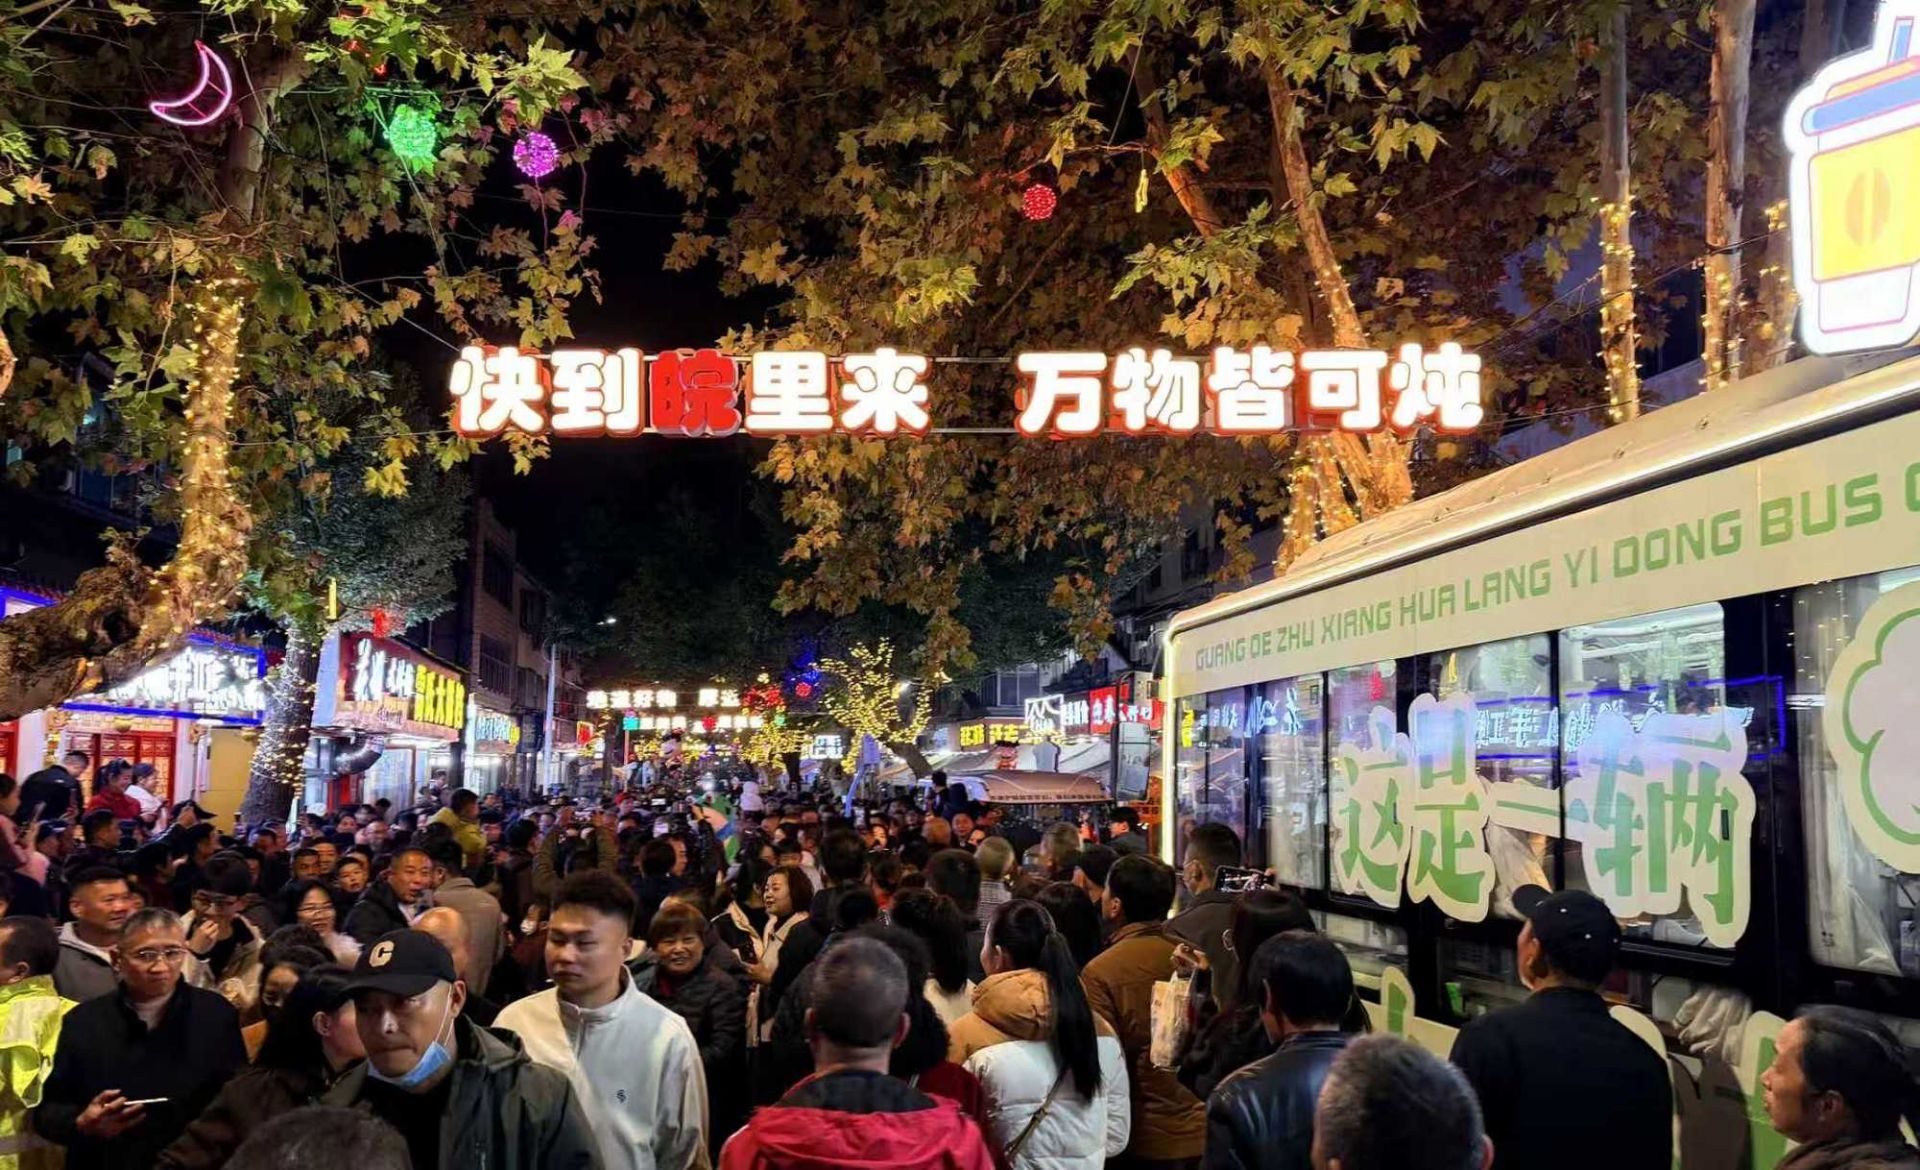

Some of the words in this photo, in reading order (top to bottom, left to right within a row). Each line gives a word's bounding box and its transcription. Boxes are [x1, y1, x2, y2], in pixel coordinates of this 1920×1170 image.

[450, 343, 932, 436] 快到皖里来
[1017, 341, 1485, 436] 万物皆可炖
[1195, 637, 1247, 671] GUANG
[1276, 620, 1315, 653] ZHU
[1321, 600, 1392, 645] XIANG
[1399, 583, 1456, 627] HUA
[1464, 558, 1552, 612] LANG
[1563, 545, 1599, 589] YI
[1612, 509, 1743, 579] DONG
[1759, 473, 1883, 547] BUS
[1336, 703, 1745, 932] 这是一辆
